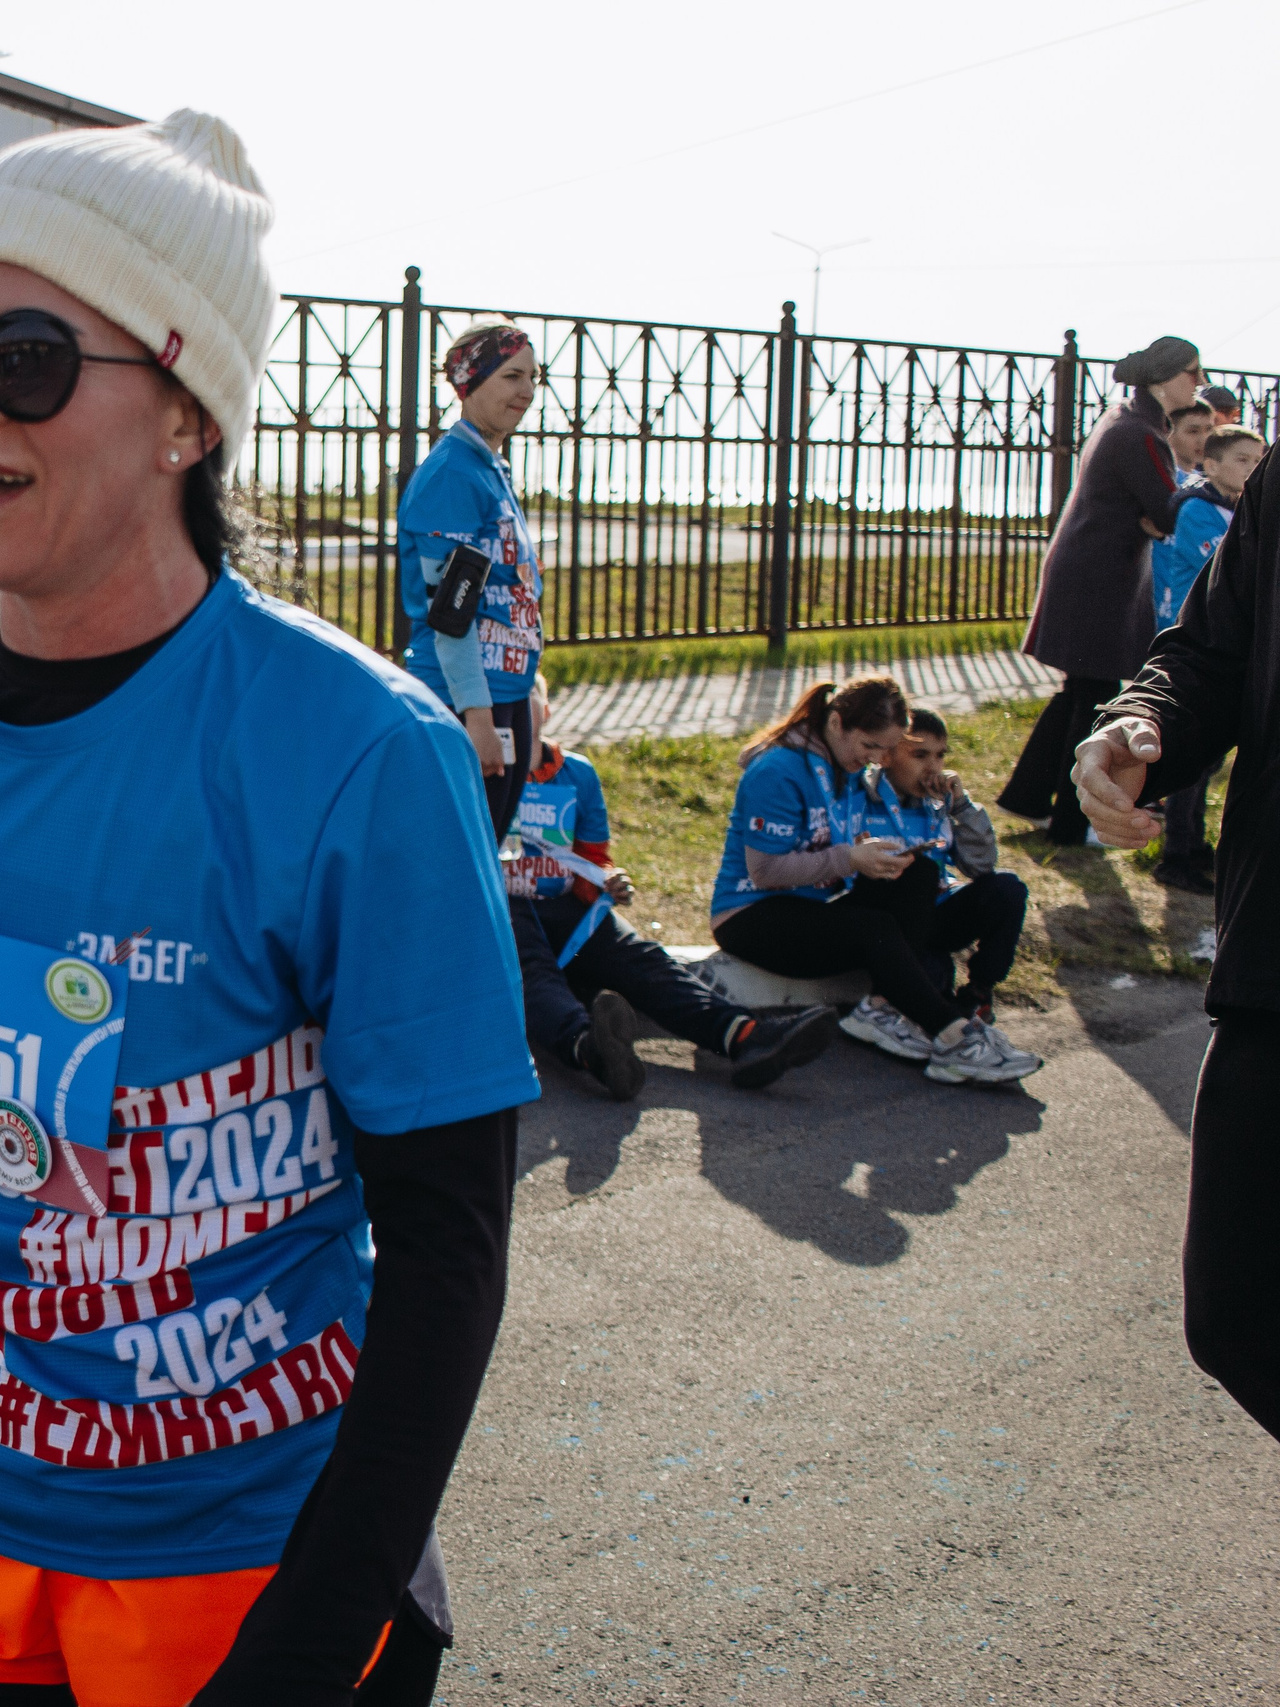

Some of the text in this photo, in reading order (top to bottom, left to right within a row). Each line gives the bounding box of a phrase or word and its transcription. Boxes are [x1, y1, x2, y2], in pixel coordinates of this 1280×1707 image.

[481, 643, 529, 676] ЗАБЕГ
[9, 1114, 37, 1161] ВЫЗОВ
[169, 1087, 339, 1214] 2024
[114, 1286, 289, 1399] 2024
